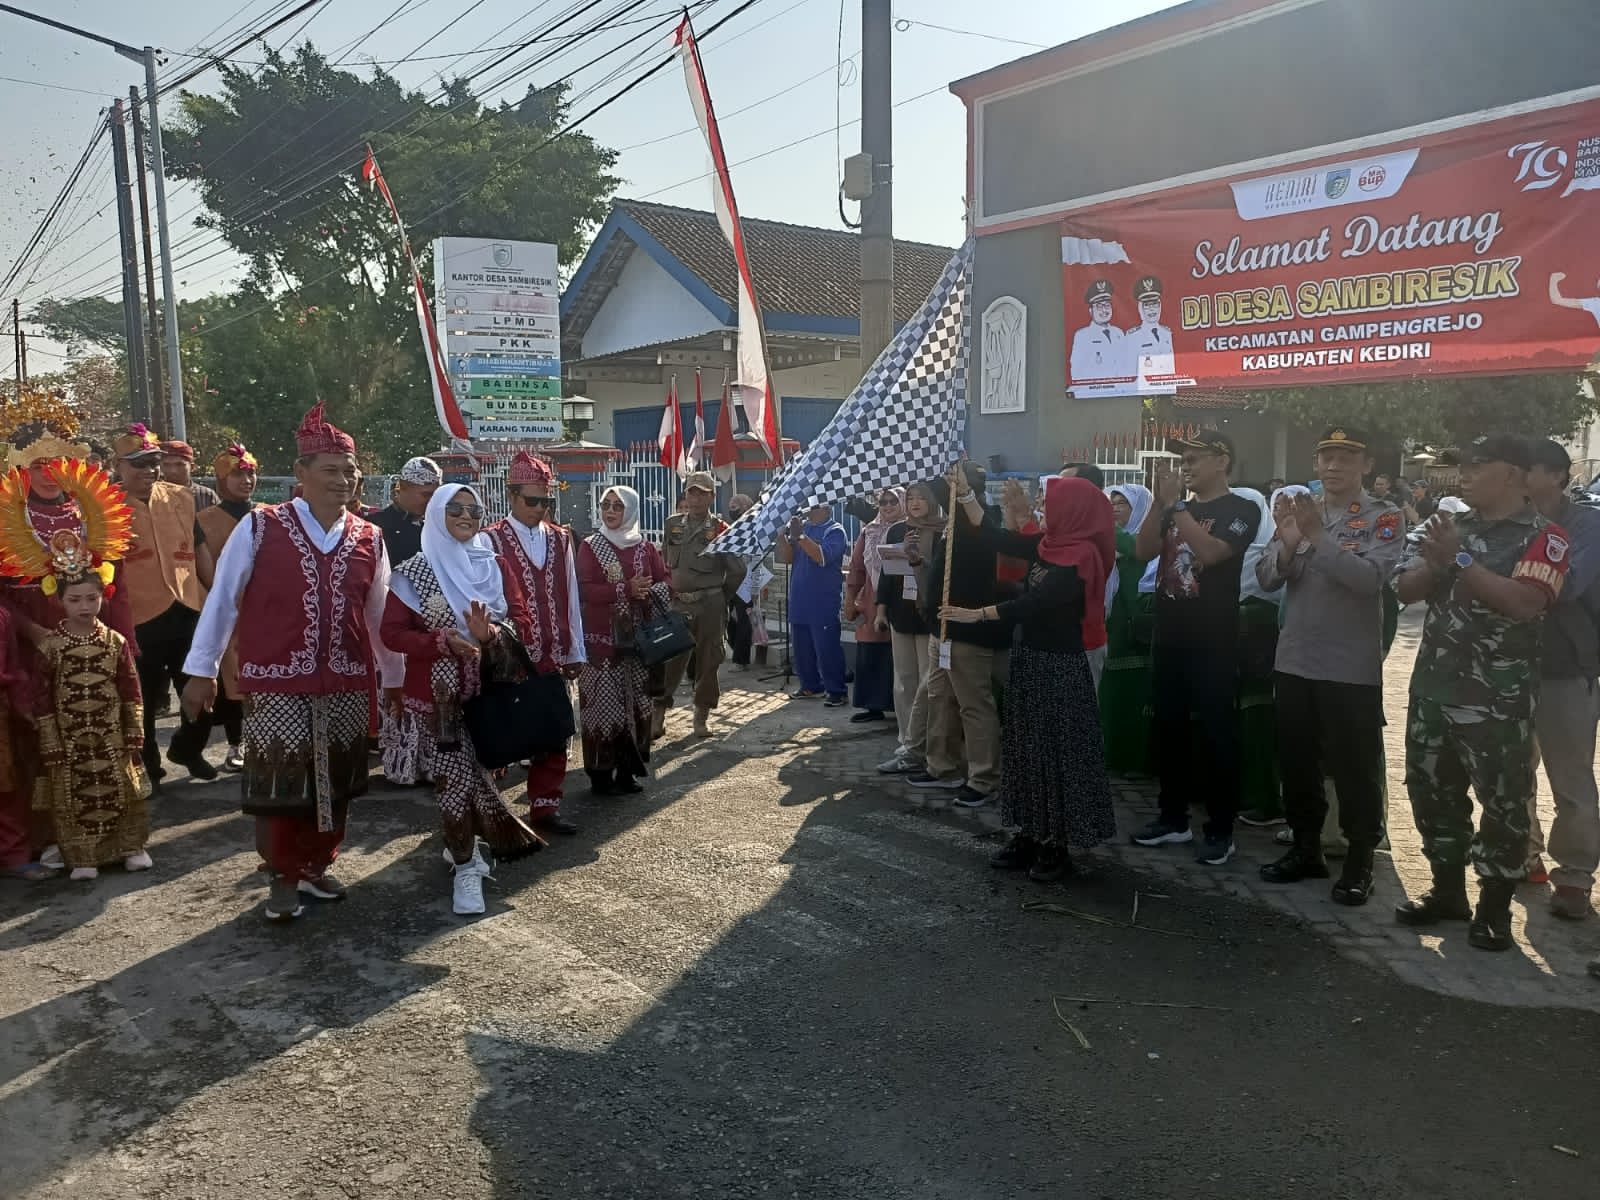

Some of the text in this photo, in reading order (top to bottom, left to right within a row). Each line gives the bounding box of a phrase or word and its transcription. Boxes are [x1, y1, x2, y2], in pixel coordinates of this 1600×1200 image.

[1507, 139, 1568, 192] 79
[1190, 210, 1503, 279] Selamat Datang
[452, 273, 553, 286] KANTOR DESA SAMBIRESIK
[1181, 255, 1521, 330] DI DESA SAMBIRESIK
[1205, 312, 1483, 352] KECAMATAN GAMPENGREJO
[1242, 341, 1431, 370] KABUPATEN KEDIRI
[483, 379, 549, 389] BABINSA
[486, 401, 547, 410] BUMDES
[479, 425, 555, 433] KARANG TARUNA
